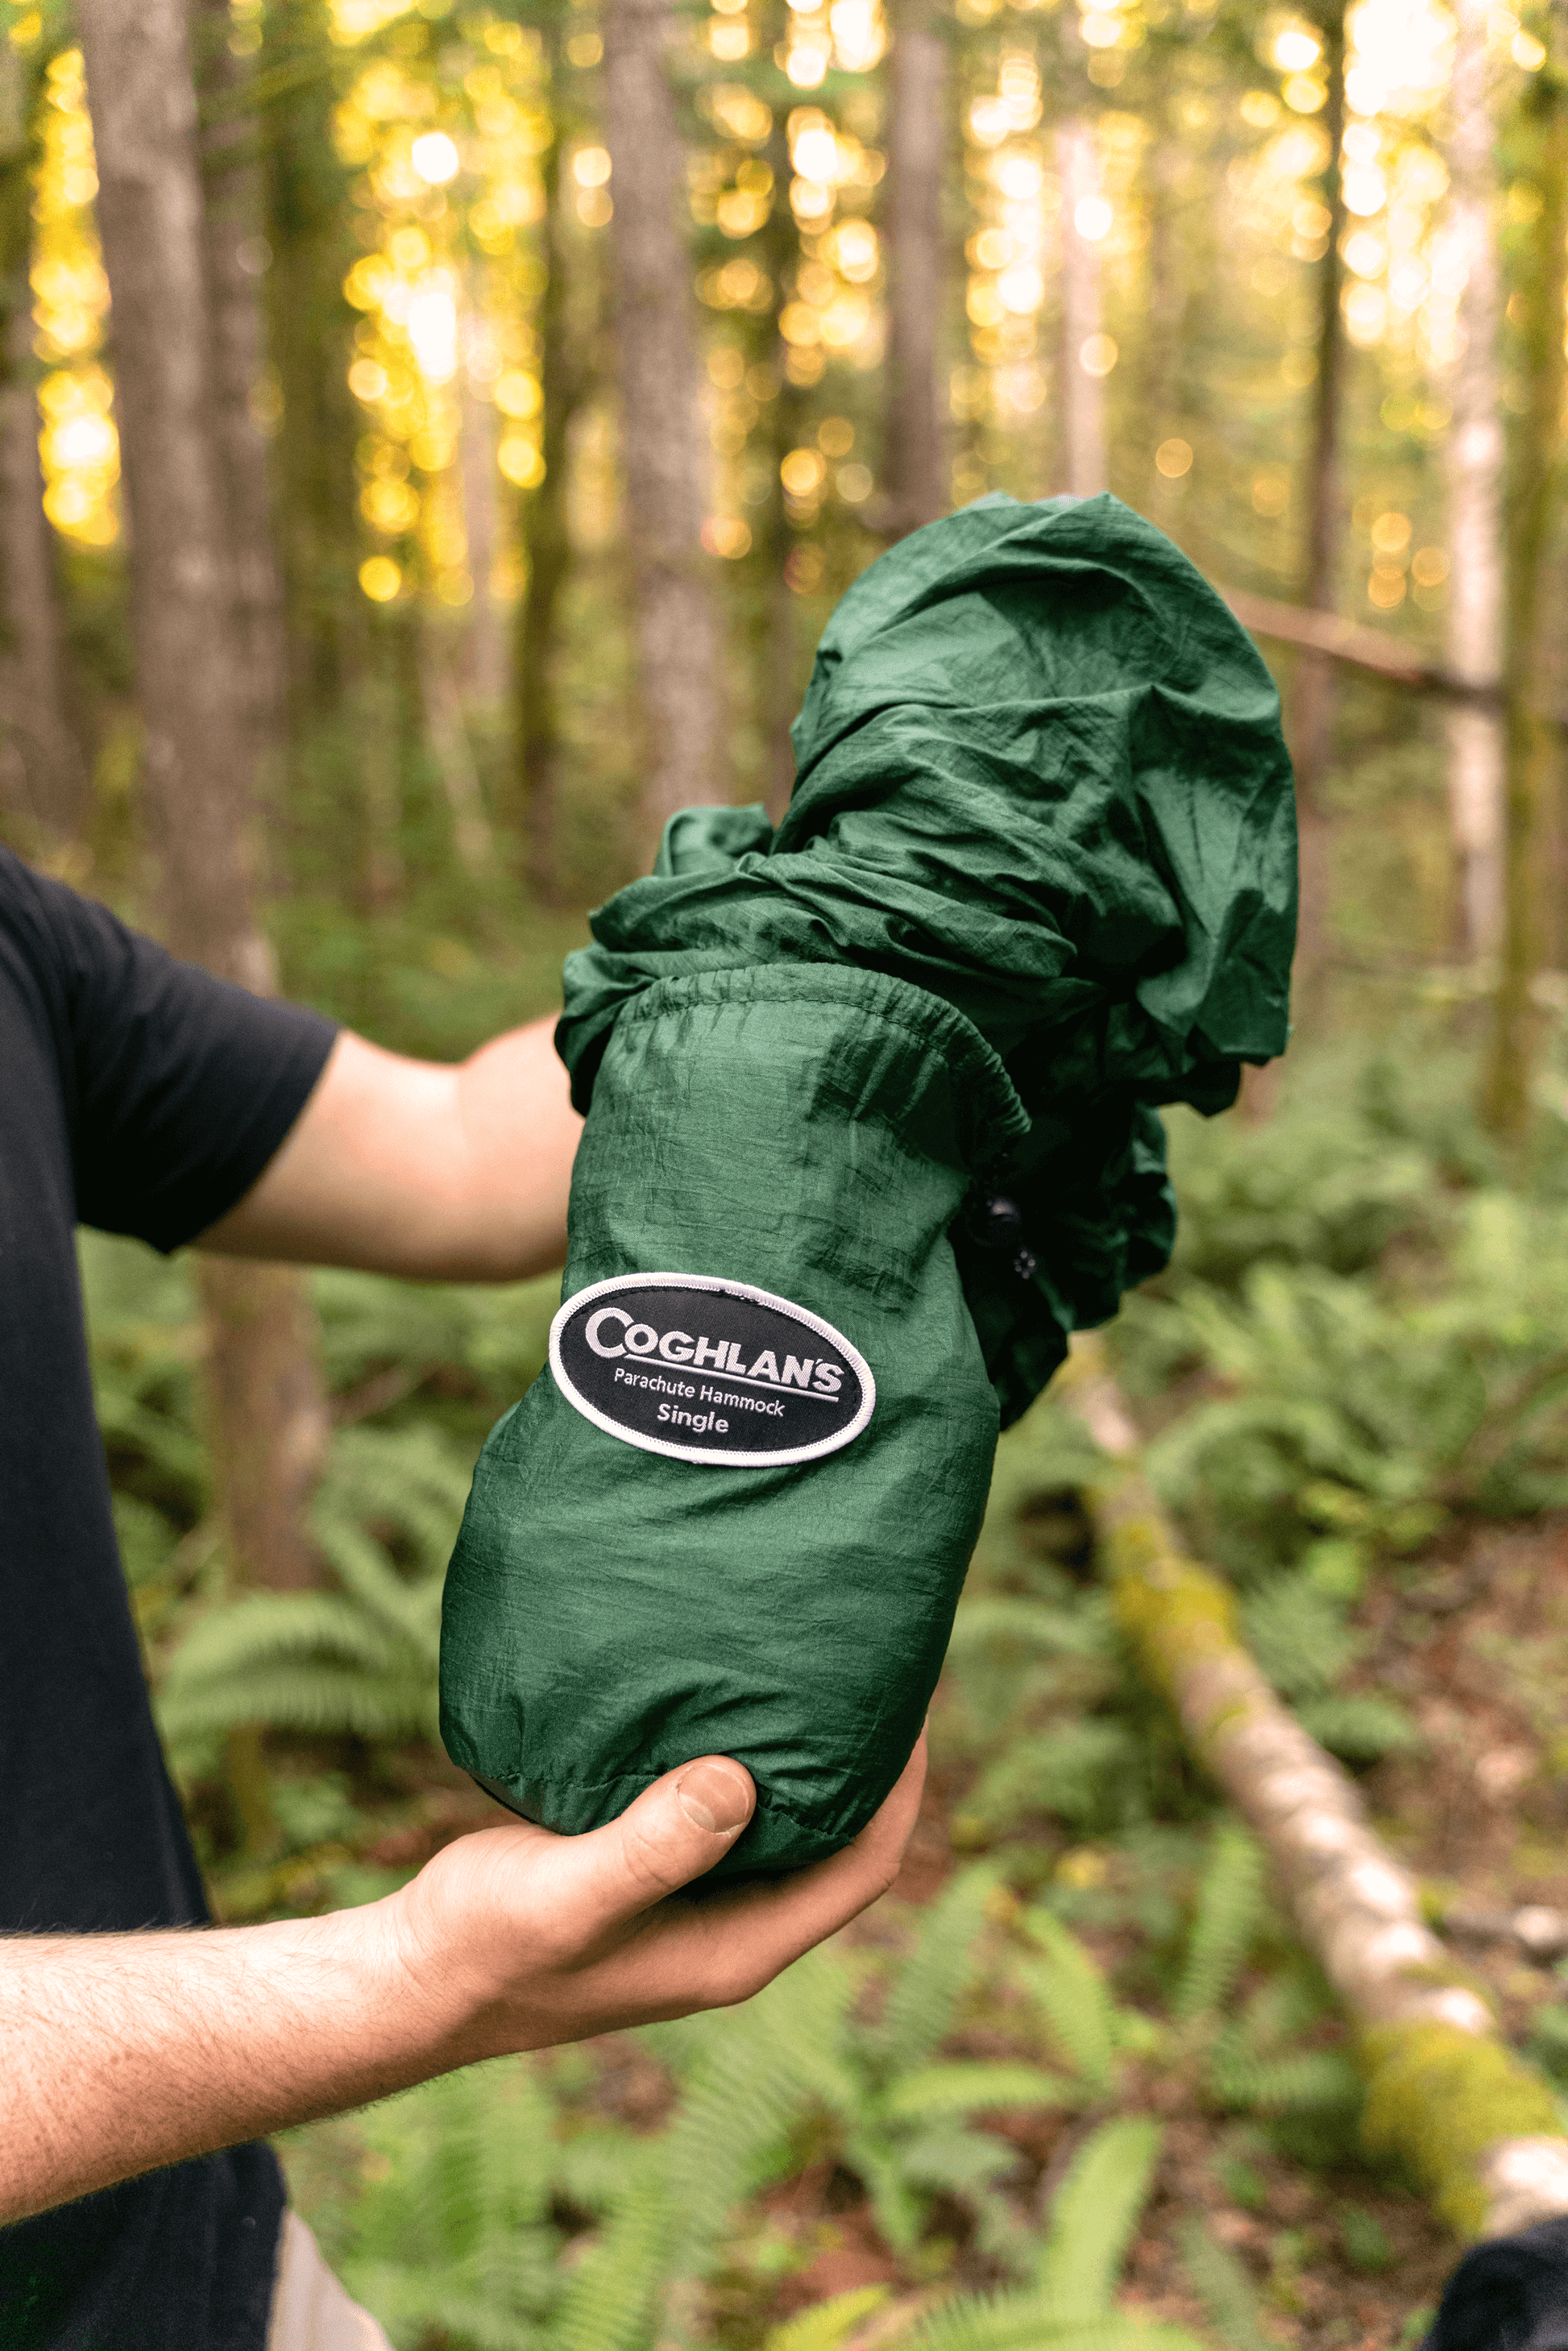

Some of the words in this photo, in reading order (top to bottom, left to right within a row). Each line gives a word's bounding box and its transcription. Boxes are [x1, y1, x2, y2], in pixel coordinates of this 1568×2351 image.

[585, 1306, 844, 1393] COGHLAN'S
[614, 1368, 695, 1398] Parachute
[699, 1385, 785, 1417] Hammock
[657, 1403, 729, 1433] Single
